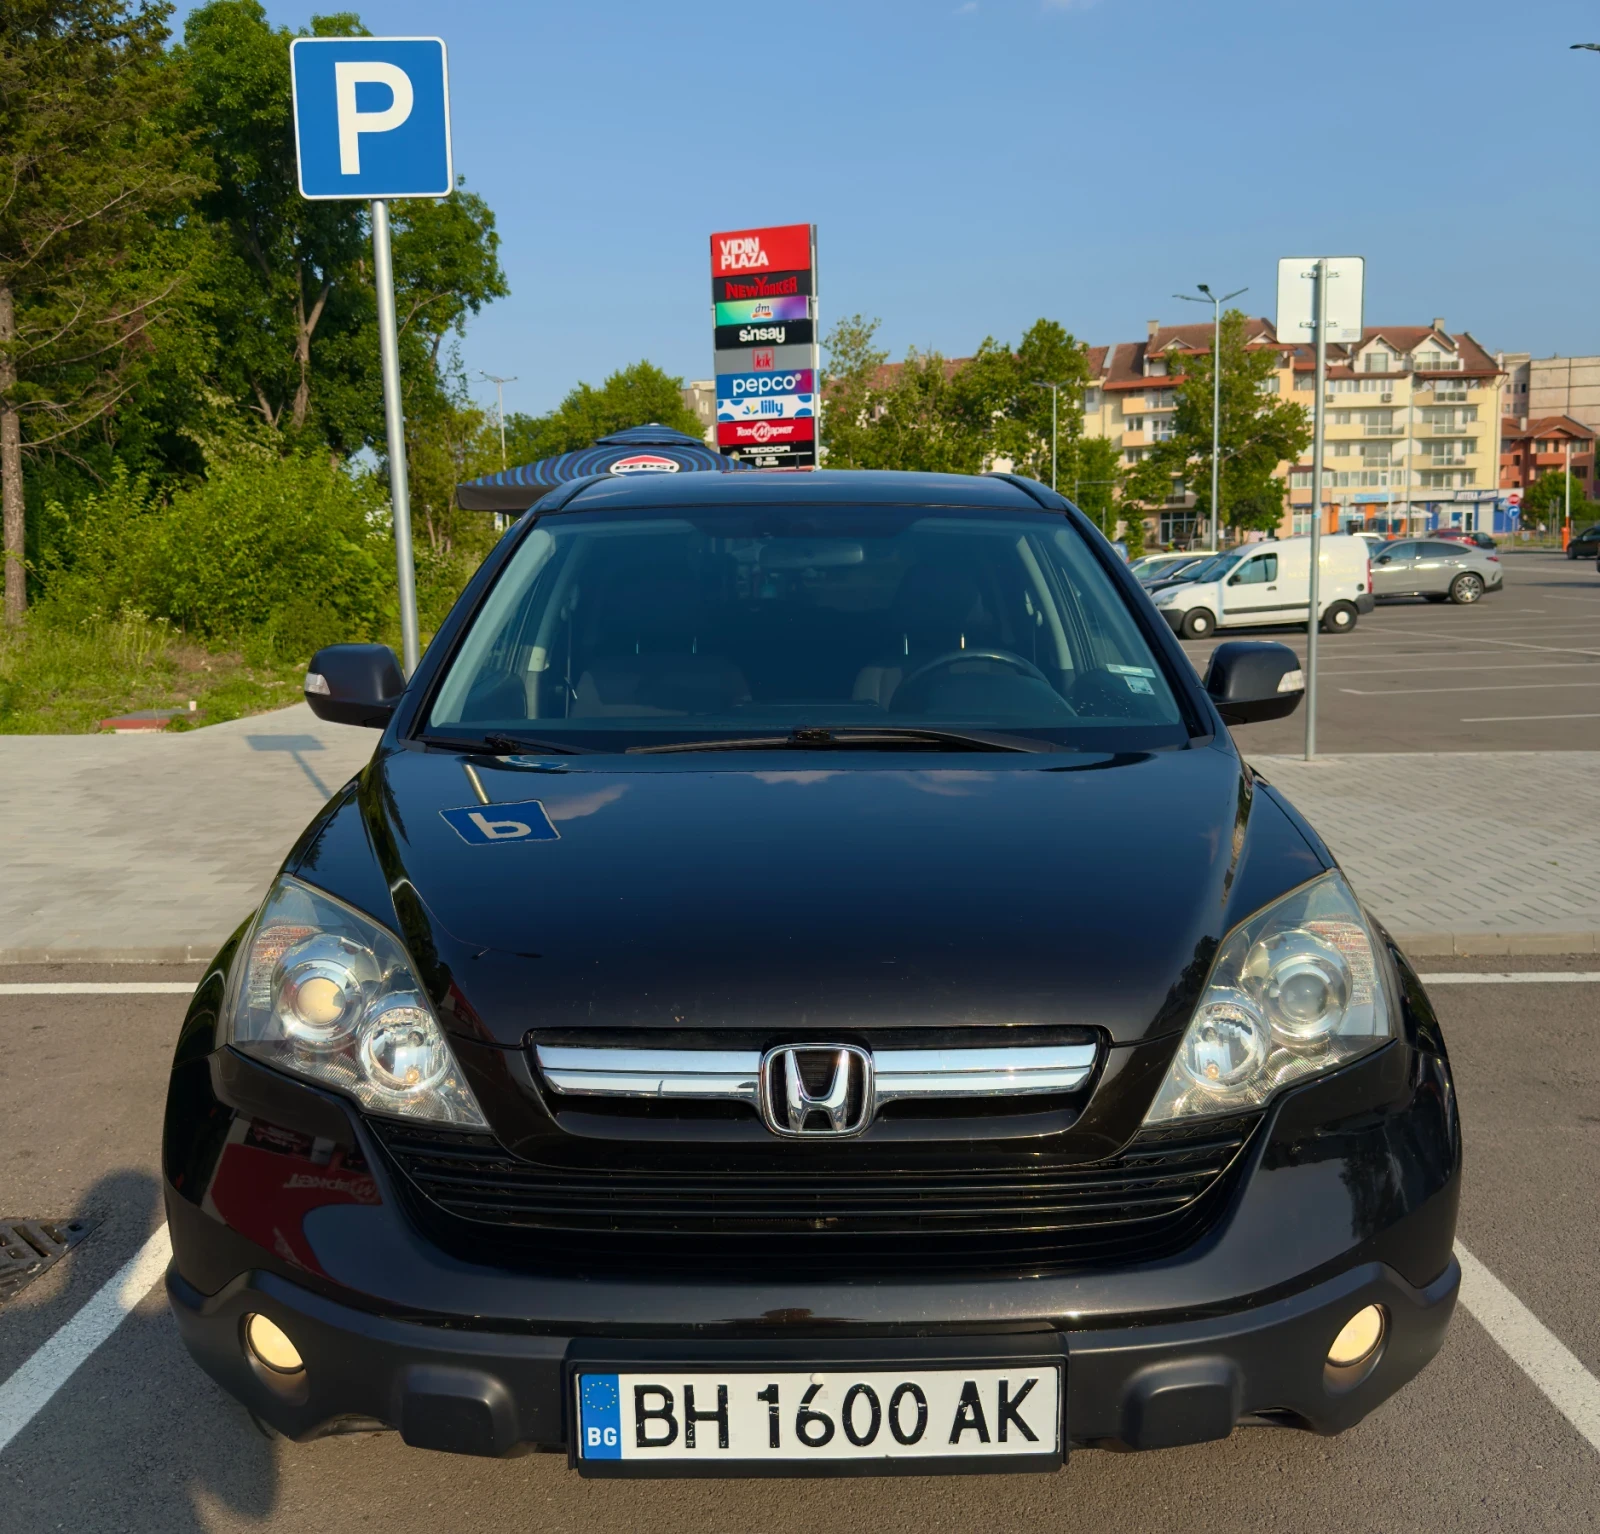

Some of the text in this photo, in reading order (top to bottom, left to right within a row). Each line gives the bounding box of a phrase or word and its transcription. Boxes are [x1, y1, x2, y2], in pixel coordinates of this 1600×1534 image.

[335, 61, 414, 175] P
[720, 237, 760, 255] VIDIN
[720, 250, 769, 270] PLAZA
[754, 303, 770, 314] dm
[738, 325, 785, 343] sinsay
[732, 375, 797, 397] pepco
[760, 400, 784, 417] lilly
[742, 445, 791, 455] TEODOR
[614, 463, 675, 471] PEPSI
[757, 1381, 928, 1448] 1600
[948, 1378, 1040, 1444] AK
[587, 1427, 617, 1447] BG
